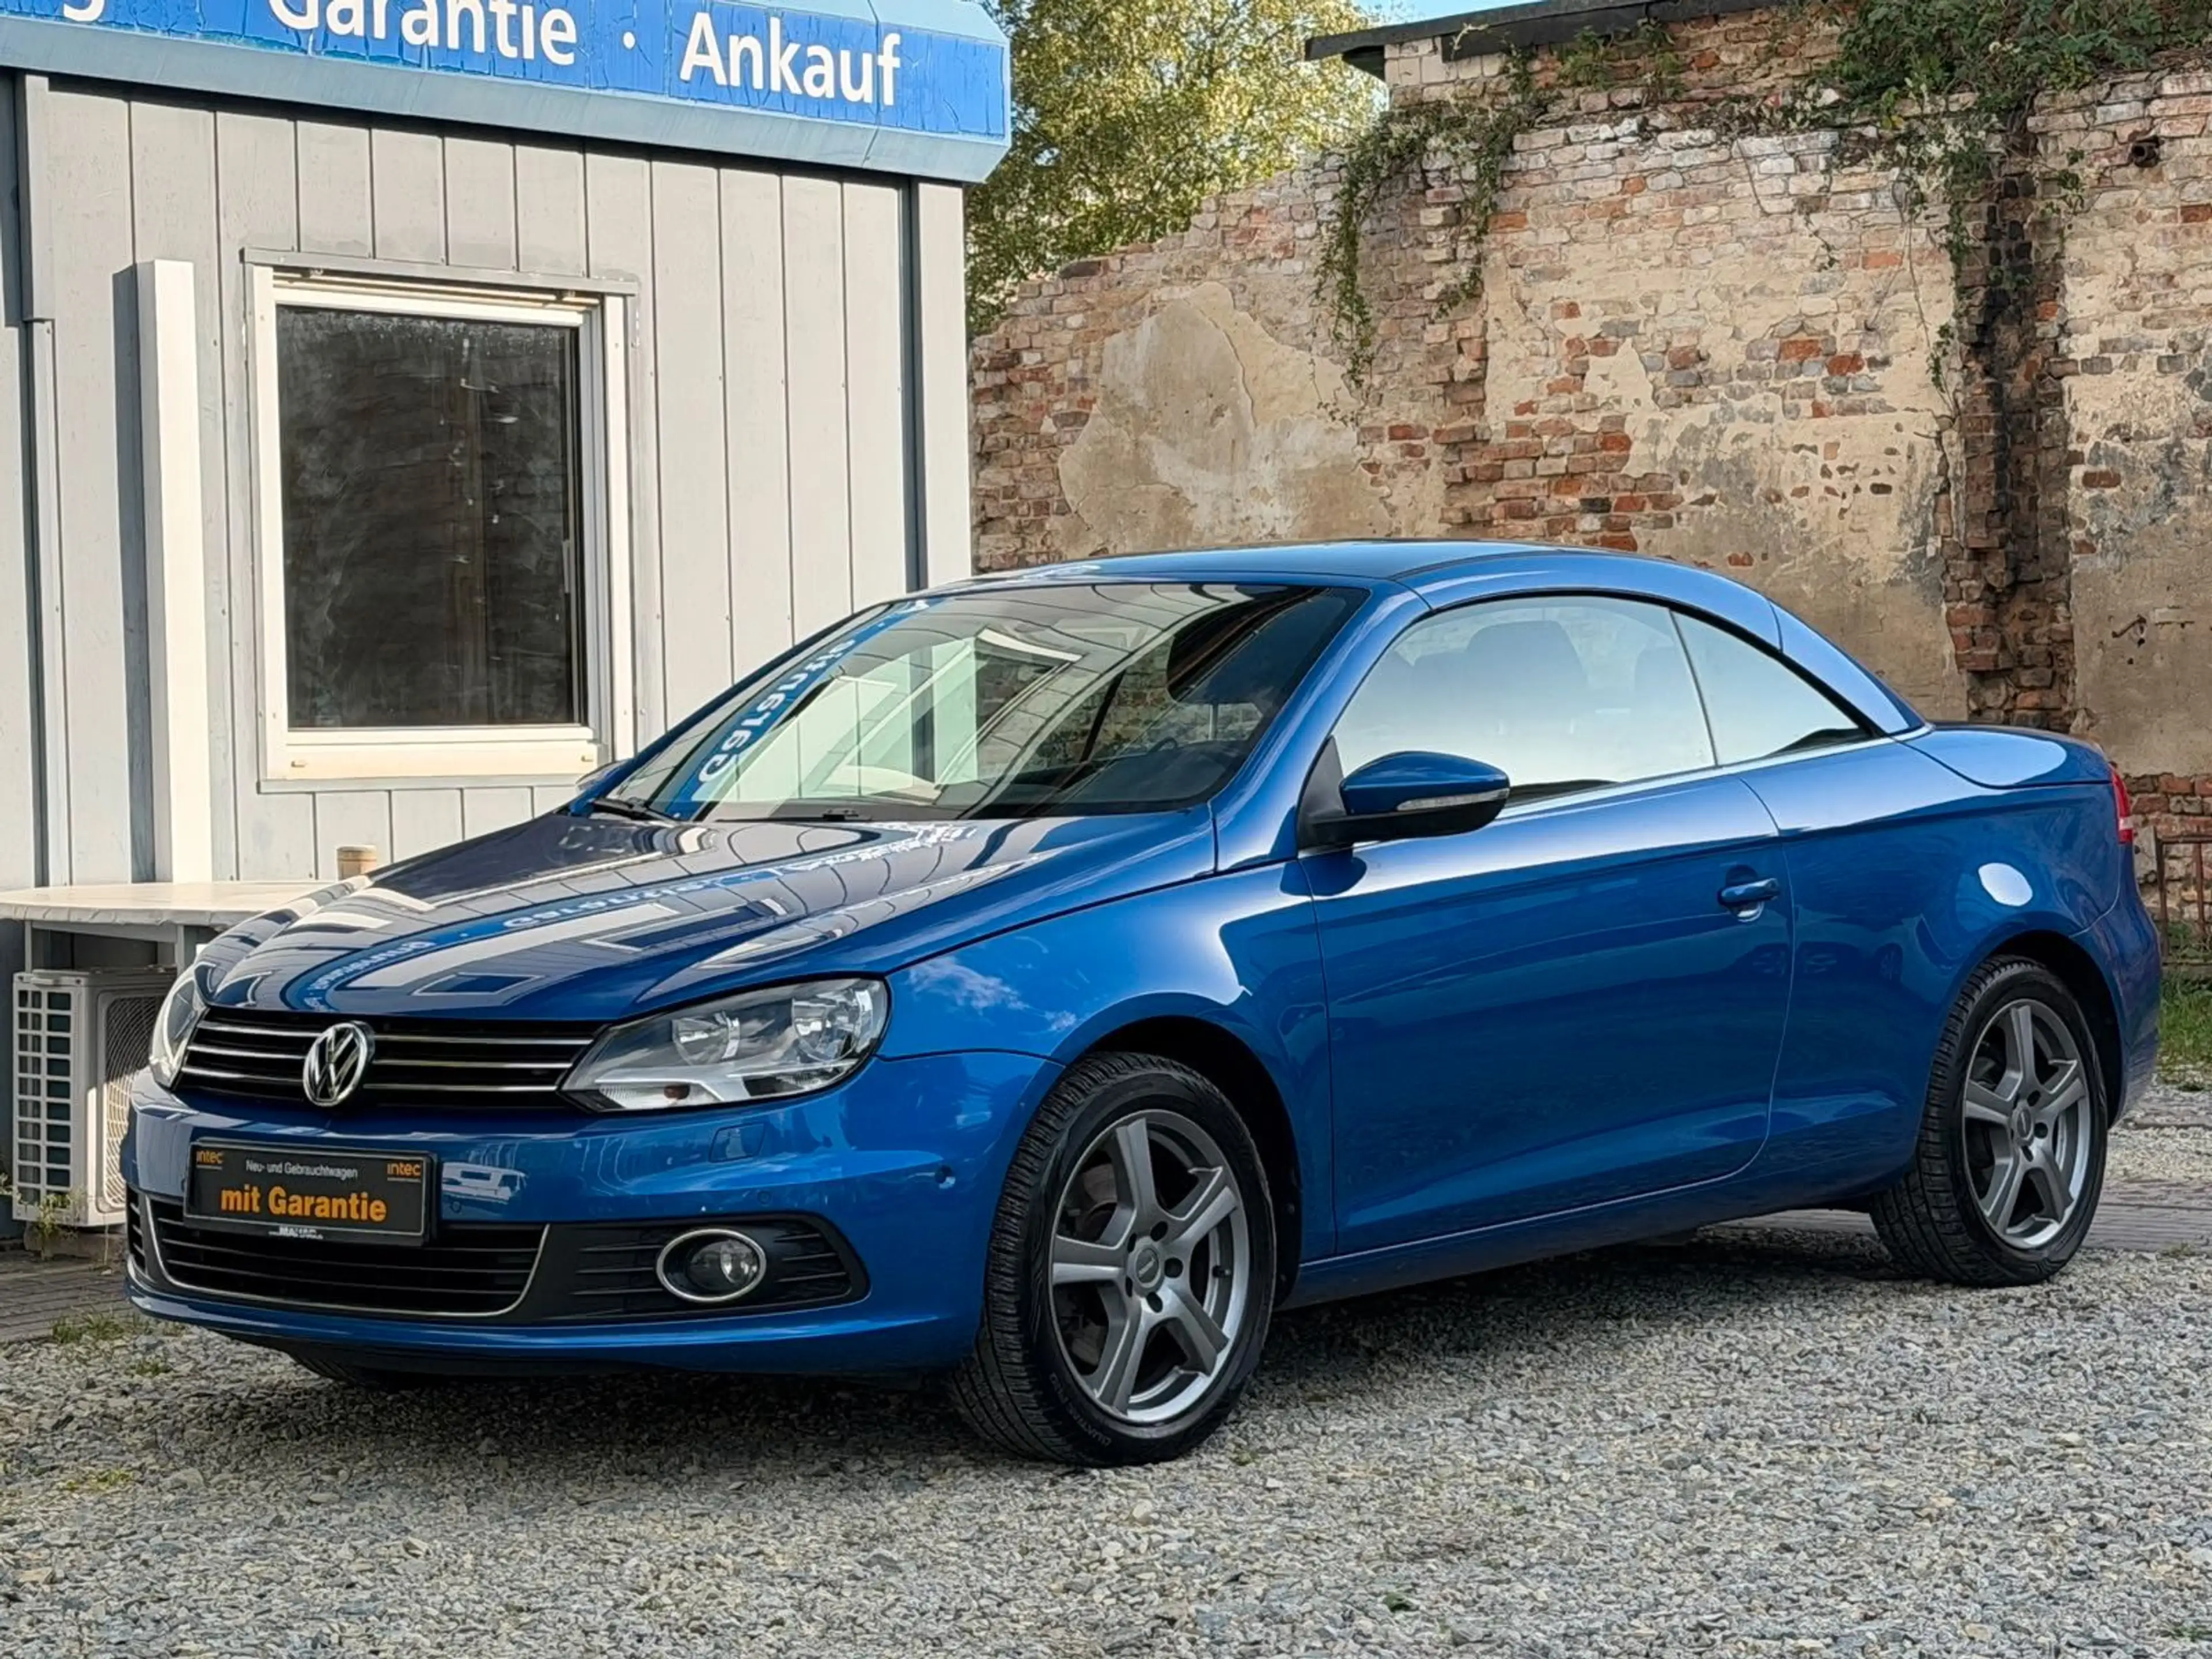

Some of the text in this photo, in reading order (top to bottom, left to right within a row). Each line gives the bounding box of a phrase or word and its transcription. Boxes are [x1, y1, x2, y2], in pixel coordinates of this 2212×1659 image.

[680, 12, 901, 106] Ankauf
[302, 1023, 368, 1107] VW
[196, 1151, 224, 1164] intec
[245, 1159, 358, 1181] Neu- und Gebrauchtwagen
[387, 1161, 421, 1176] intec
[221, 1184, 387, 1222] mit Garantie
